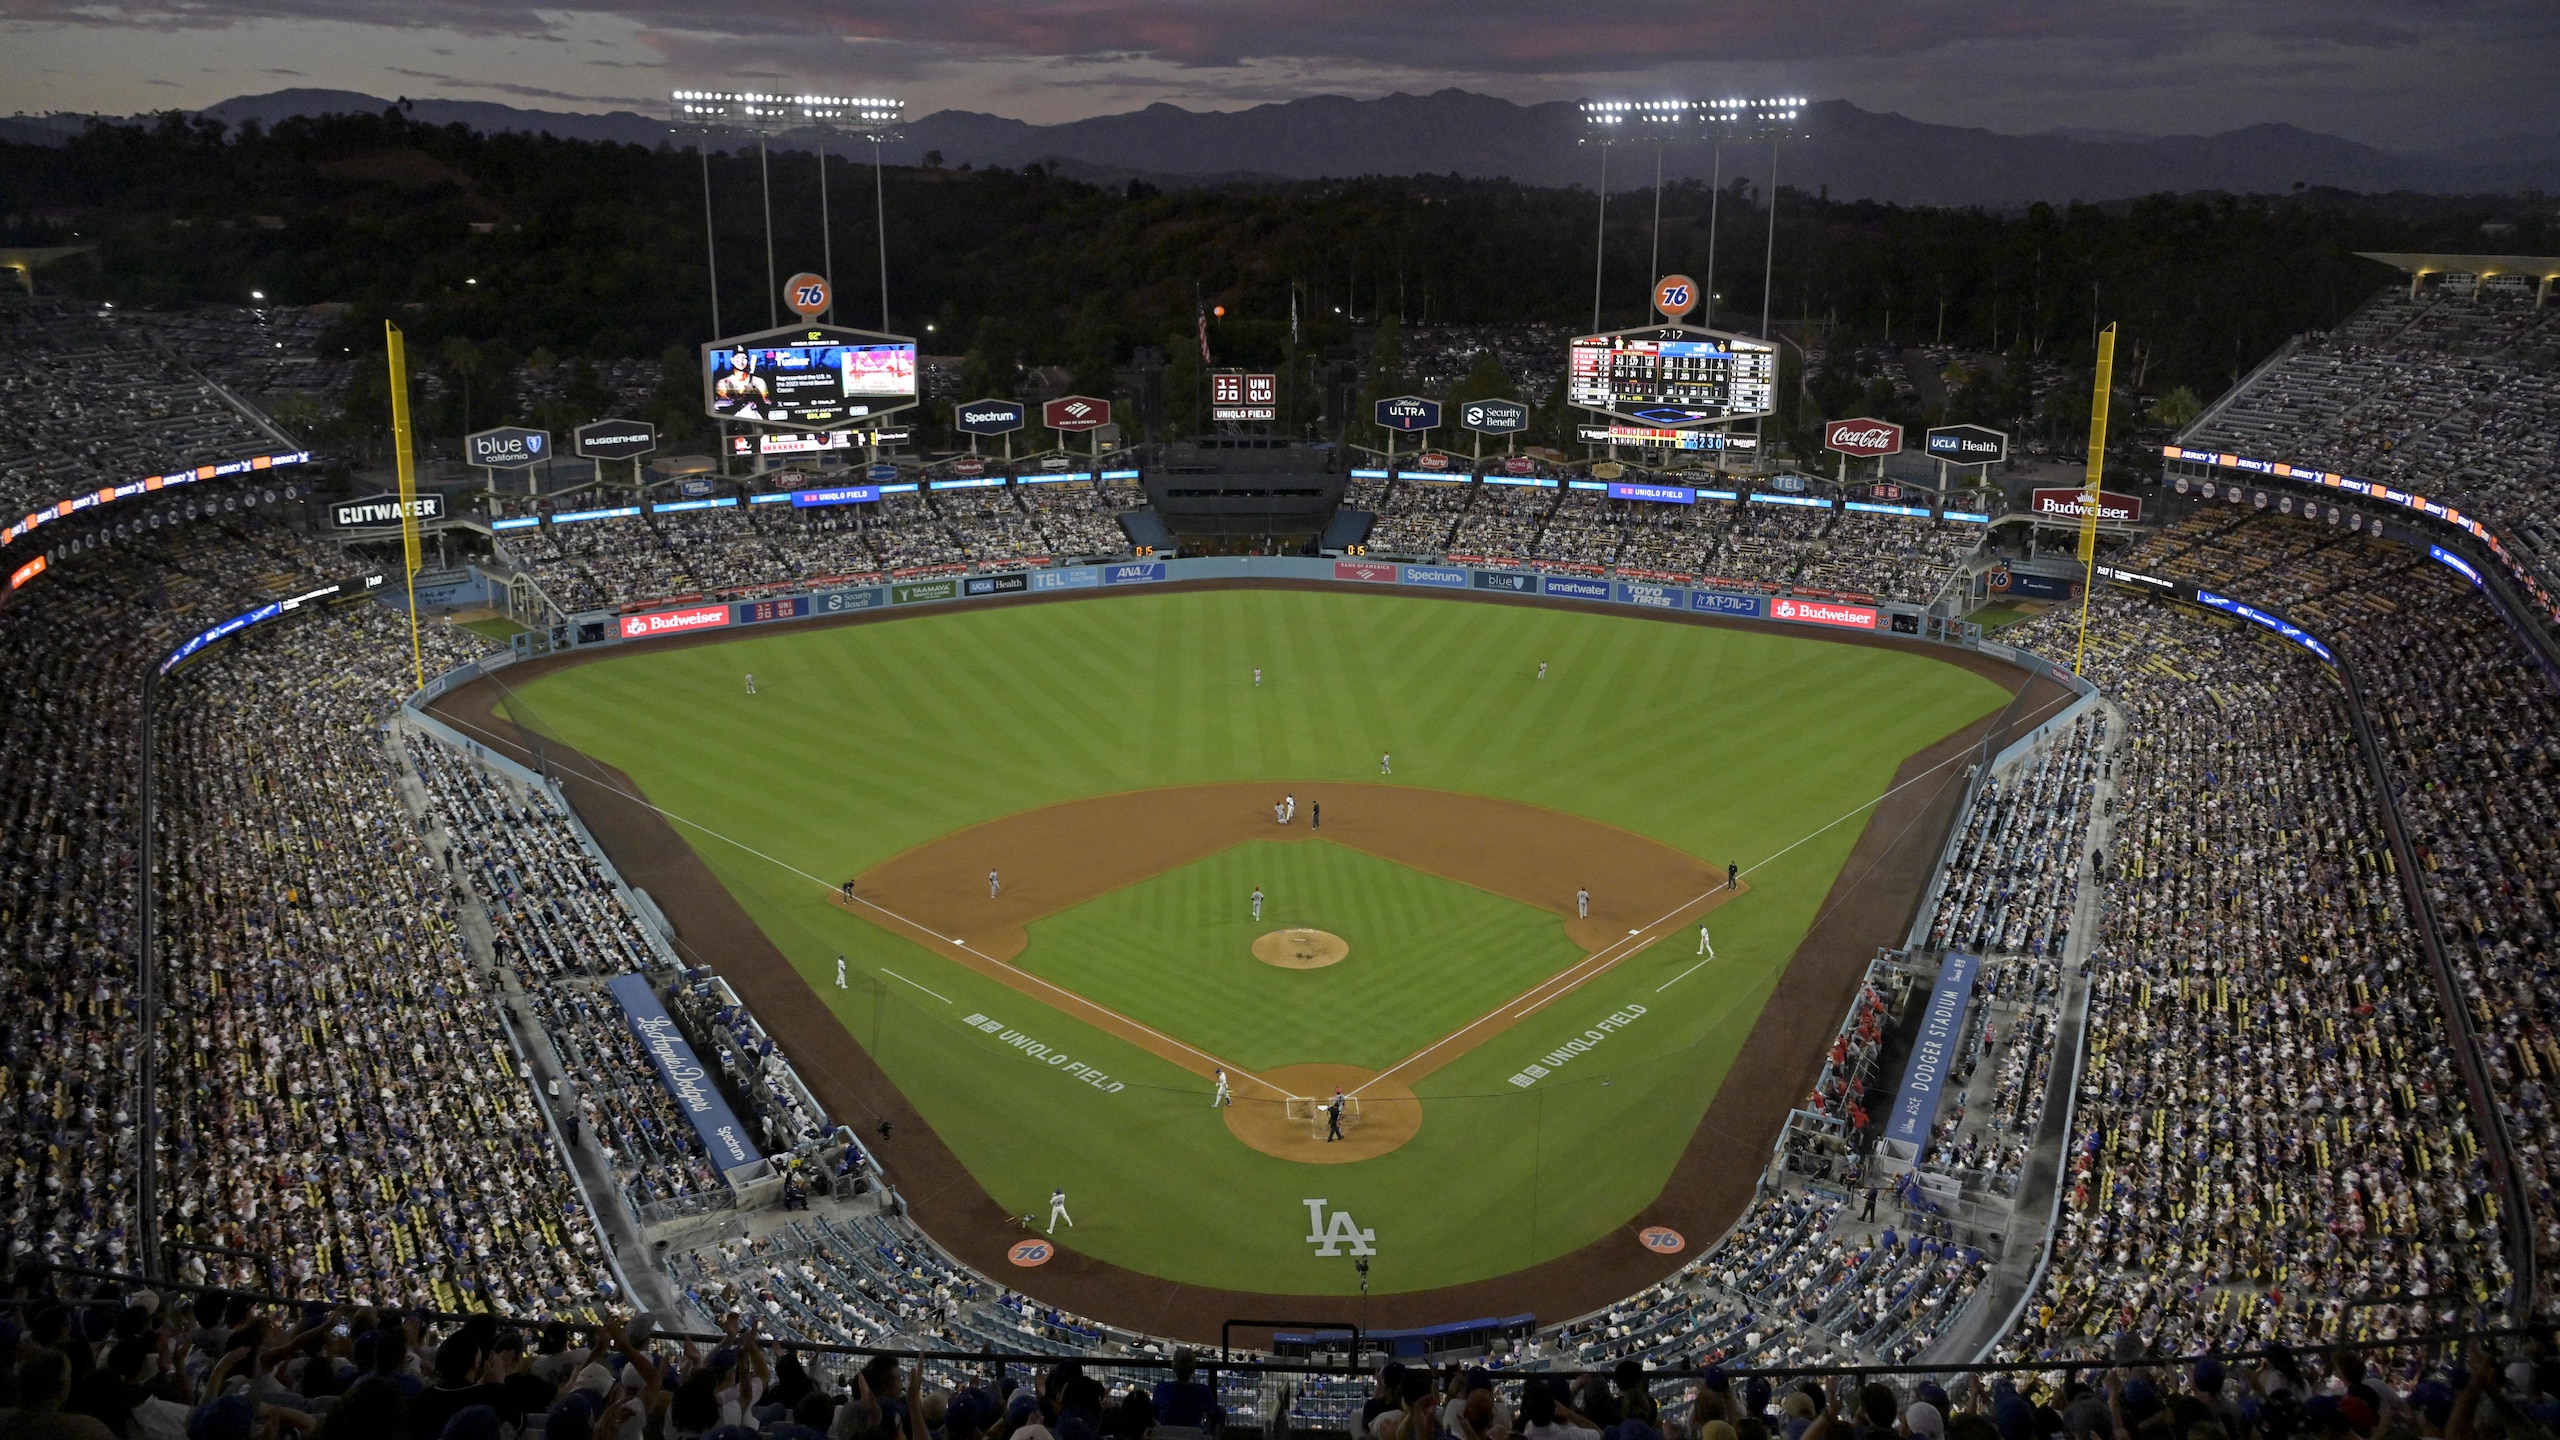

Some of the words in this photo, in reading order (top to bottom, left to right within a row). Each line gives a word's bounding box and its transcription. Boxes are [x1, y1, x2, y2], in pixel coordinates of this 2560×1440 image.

[797, 284, 824, 306] 76
[1662, 285, 1688, 306] 76
[1660, 330, 1683, 339] 7:17
[775, 357, 810, 366] Tucker
[1250, 379, 1269, 389] UNI
[1250, 390, 1271, 401] QLO
[1217, 410, 1246, 419] UNIQLO
[1389, 407, 1426, 417] ULTRA
[1486, 408, 1521, 419] Security
[965, 412, 1013, 424] Spectrum
[1486, 417, 1516, 427] Benefit
[585, 434, 649, 446] GUGGENHEIM
[1832, 426, 1893, 449] Coca-Cola
[478, 438, 523, 455] blue
[1932, 439, 1957, 449] UCLA
[1962, 440, 1997, 453] Health
[272, 454, 297, 464] JERKY
[486, 452, 528, 463] california
[2181, 450, 2207, 460] JERKY
[1421, 457, 1447, 466] Churu
[2237, 459, 2262, 469] JERKY
[216, 464, 241, 474] JERKY
[2290, 468, 2314, 478] JERKY
[164, 474, 186, 485] JERKY
[781, 473, 802, 482] JINRO
[1777, 478, 1800, 489] TEL
[2340, 479, 2362, 490] JERKY
[115, 485, 136, 496] JERKY
[2386, 490, 2404, 502] JERKY
[339, 500, 436, 524] CUTWATER
[1136, 546, 1153, 556] 0:15
[1348, 545, 1364, 556] 0:15
[1117, 567, 1140, 578] ANA
[1407, 569, 1459, 582] Spectrum
[995, 579, 1022, 588] Health
[1036, 574, 1064, 586] TEL
[1489, 575, 1512, 586] blue
[1990, 572, 2008, 587] 76
[1548, 581, 1606, 595] smartwater
[1627, 586, 1662, 596] TOYO
[844, 592, 872, 600] Security
[1632, 594, 1671, 606] TIRES
[845, 600, 868, 608] Benefit
[1706, 596, 1755, 611] 木下グループ
[779, 608, 793, 617] QLO
[1799, 605, 1871, 624] Budweiser
[650, 612, 722, 629] Budweiser
[1879, 618, 1890, 626] 76
[1540, 1030, 1604, 1067] UNIQLO
[1596, 1004, 1647, 1033] FIELD
[1911, 1041, 1942, 1092] DODGER
[1929, 990, 1958, 1038] STADIUM
[999, 1029, 1068, 1066] UNIQLO
[1062, 1061, 1124, 1093] FIELD
[671, 1068, 712, 1112] Dodgers
[716, 1125, 743, 1160] Spectrum
[1303, 1199, 1376, 1257] LA
[1646, 1232, 1678, 1248] 76
[1013, 1244, 1048, 1261] 76
